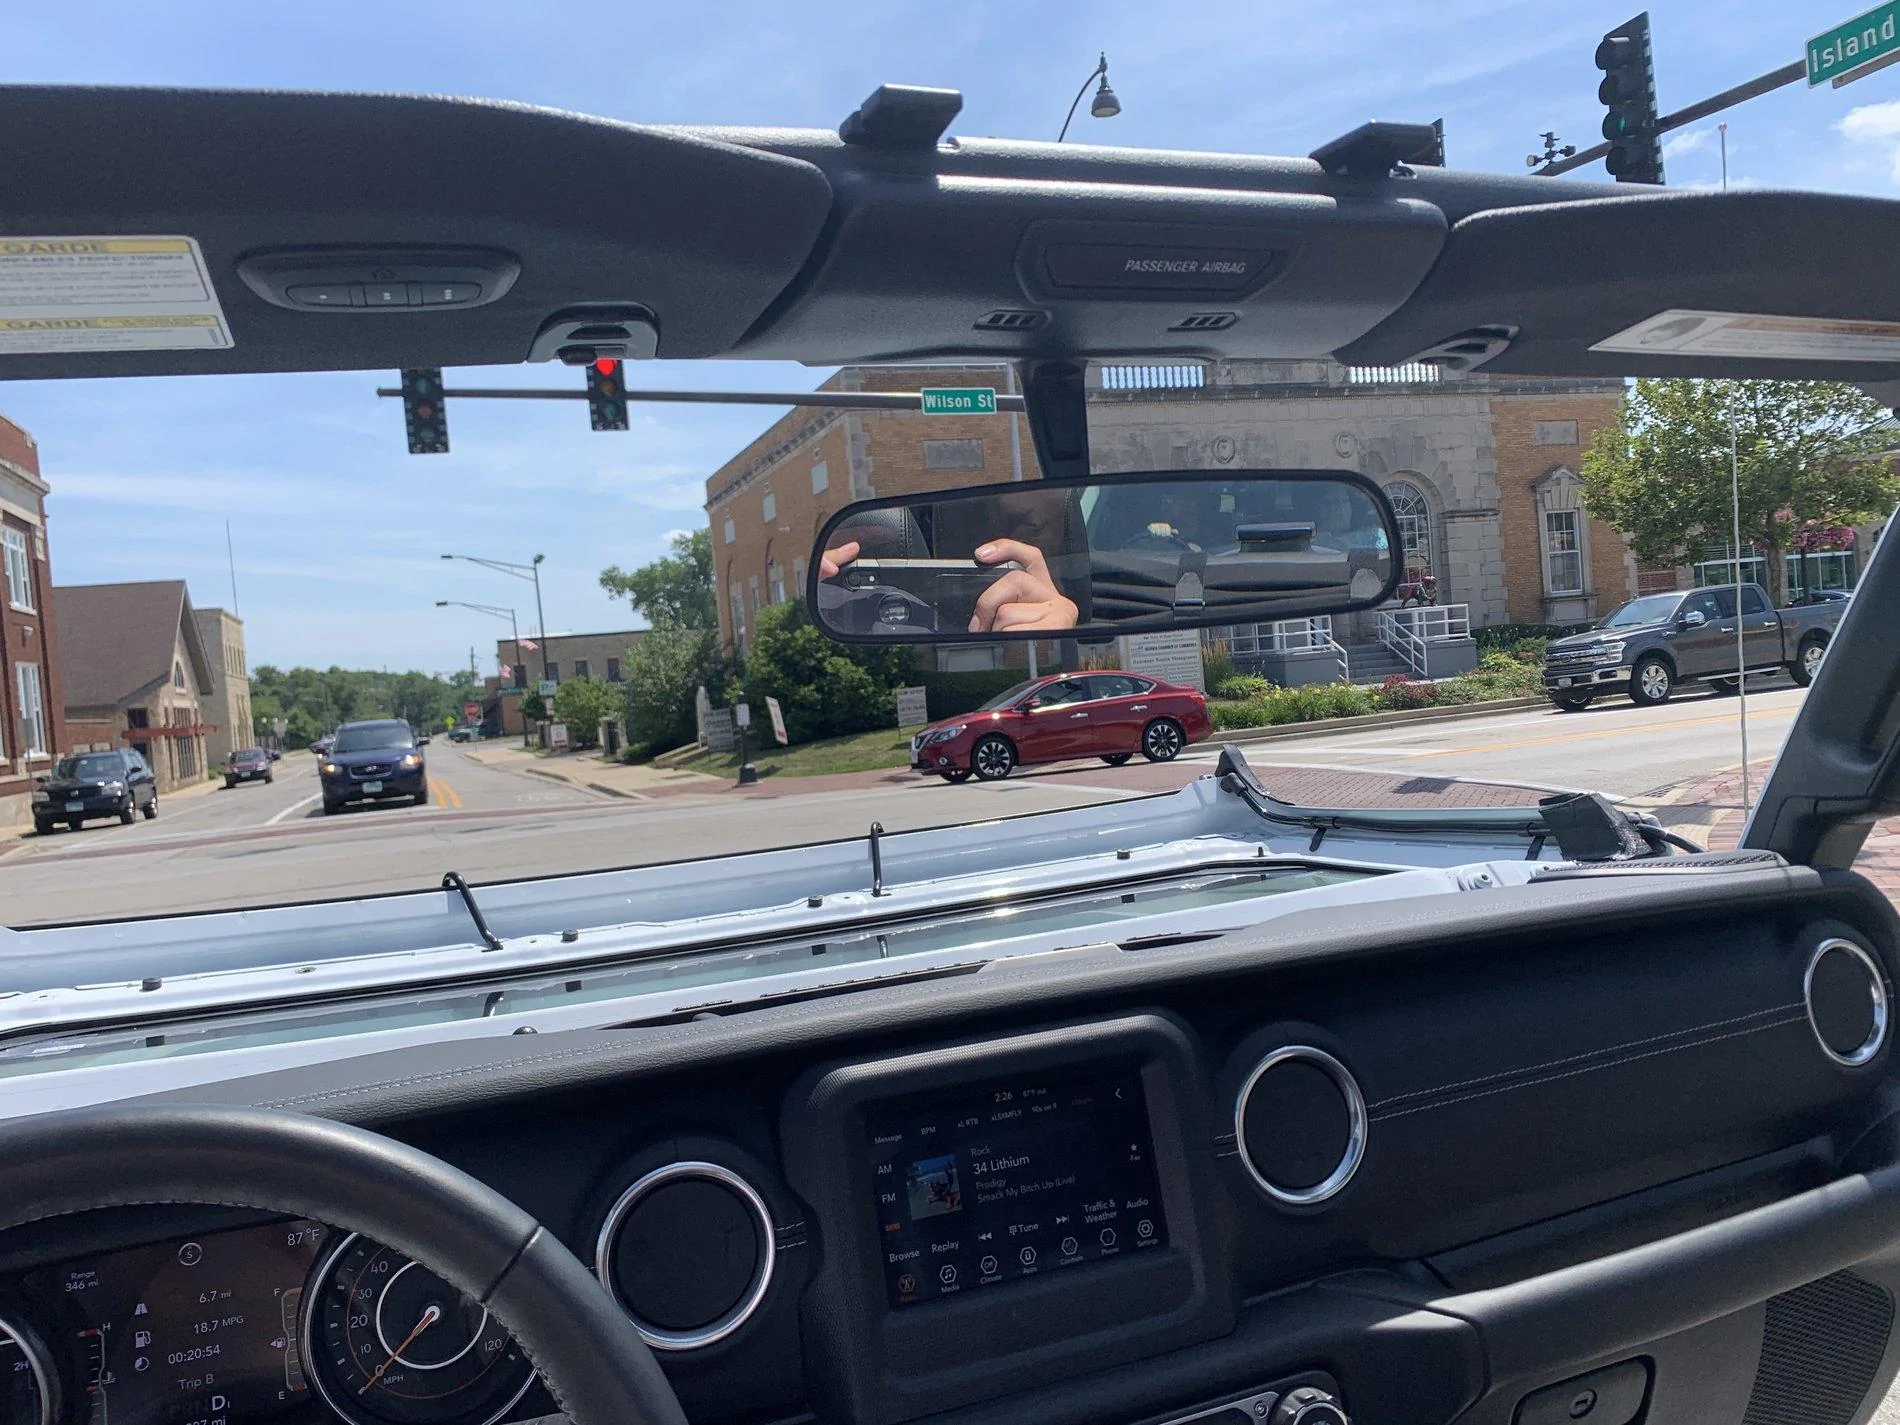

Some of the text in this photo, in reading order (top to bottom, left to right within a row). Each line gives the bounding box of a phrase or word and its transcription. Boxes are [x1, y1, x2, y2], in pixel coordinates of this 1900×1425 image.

[1812, 13, 1895, 73] Island
[1124, 260, 1247, 273] PASSENGER AIRBAG
[924, 394, 993, 408] Wilson St
[994, 1091, 1013, 1103] 2:26
[921, 1125, 937, 1136] BPM
[874, 1133, 903, 1145] Message
[970, 1146, 991, 1157] Rock
[877, 1163, 893, 1175] AM
[972, 1155, 1030, 1175] 34 Lithium
[975, 1178, 1006, 1191] Prodigy
[977, 1174, 1076, 1204] Smack My Bitch Up (Live)
[881, 1193, 896, 1203] FM
[1126, 1197, 1149, 1210] Audio
[1083, 1200, 1109, 1213] Traffic
[1084, 1210, 1118, 1224] Weather
[1018, 1222, 1039, 1233] Tune
[931, 1239, 960, 1254] Replay
[186, 1250, 193, 1259] S
[888, 1249, 920, 1263] Browse
[370, 1260, 389, 1274] 40
[70, 1269, 96, 1281] Range
[64, 1278, 99, 1293] 346 mi
[273, 1287, 280, 1297] F
[198, 1289, 232, 1304] 6.7 mi
[358, 1288, 373, 1300] 30
[102, 1322, 111, 1332] H
[193, 1314, 244, 1335] 18.7 MPG
[350, 1313, 369, 1329] 20
[359, 1343, 372, 1355] 10
[483, 1338, 502, 1352] 120
[167, 1344, 221, 1365] 00:20:54
[14, 1360, 29, 1372] 2H
[177, 1373, 214, 1390] Trip B
[383, 1374, 404, 1386] MPH
[277, 1390, 285, 1400] E
